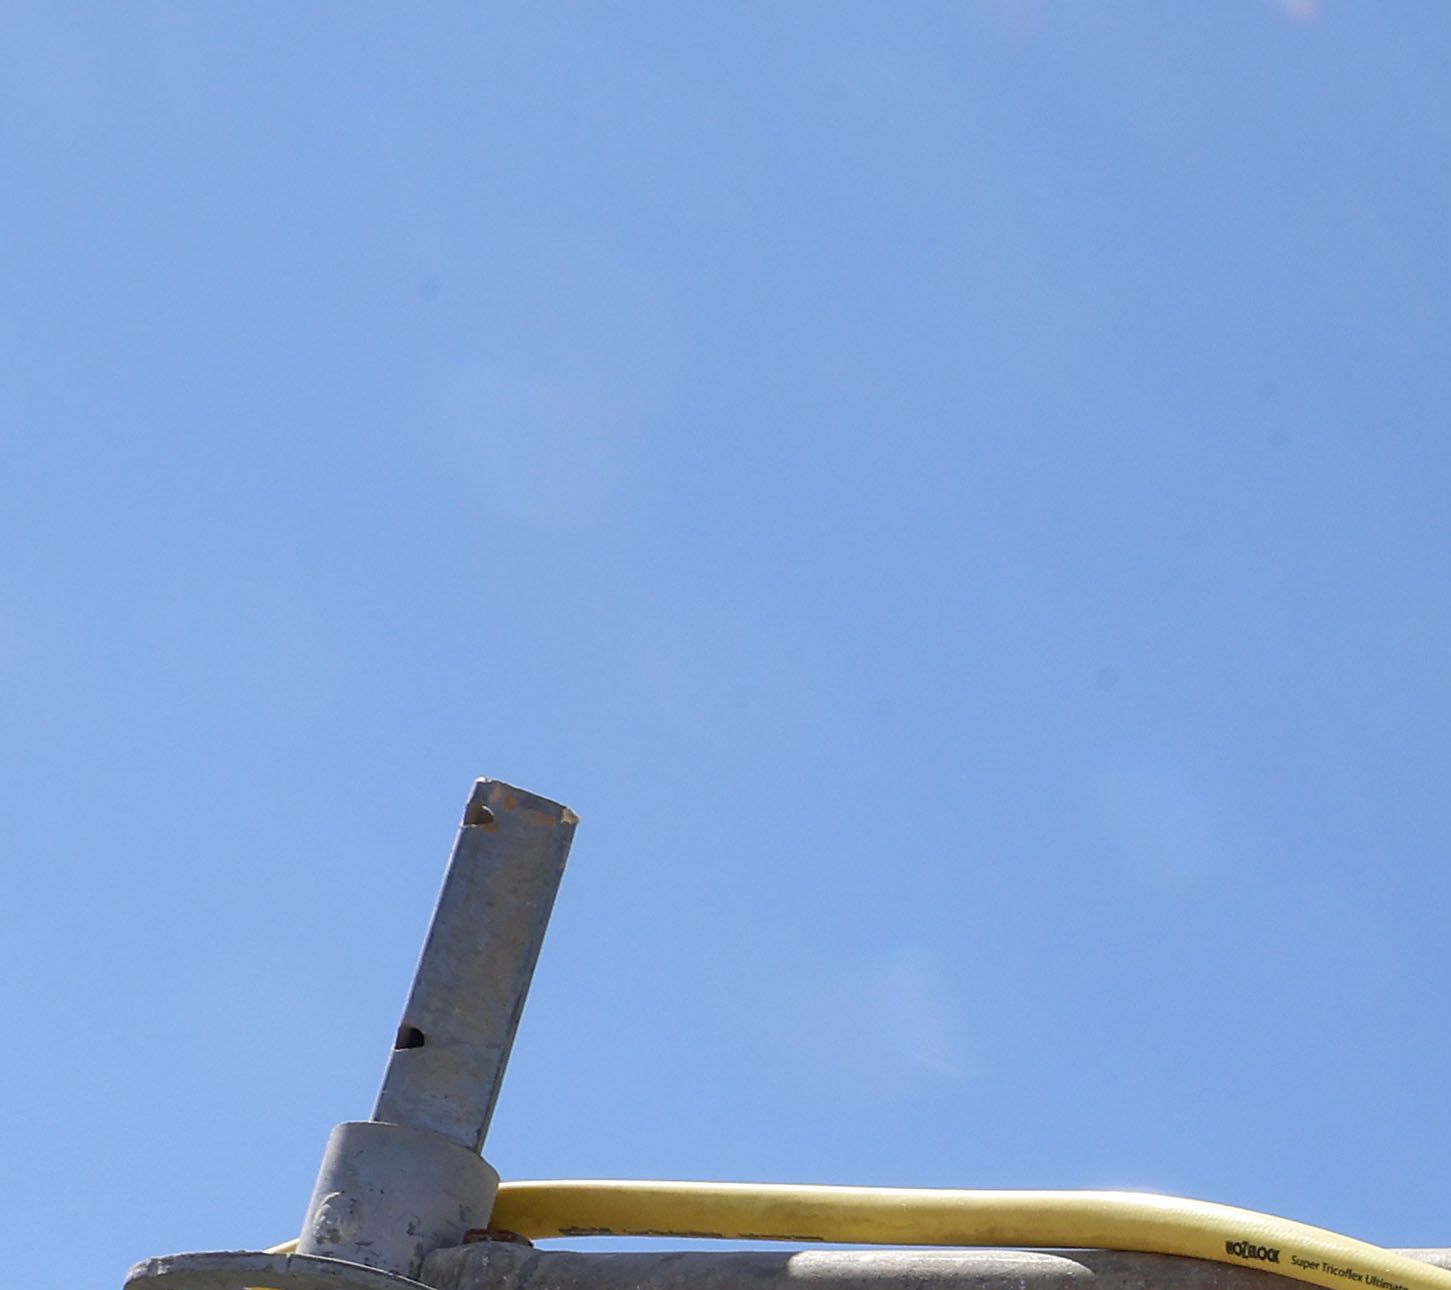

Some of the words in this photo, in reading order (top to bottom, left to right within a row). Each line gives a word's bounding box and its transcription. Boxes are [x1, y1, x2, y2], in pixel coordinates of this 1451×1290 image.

[1225, 1240, 1280, 1264] HOZELOCK
[1291, 1255, 1320, 1271] Super
[1322, 1263, 1363, 1282] Tricoflex
